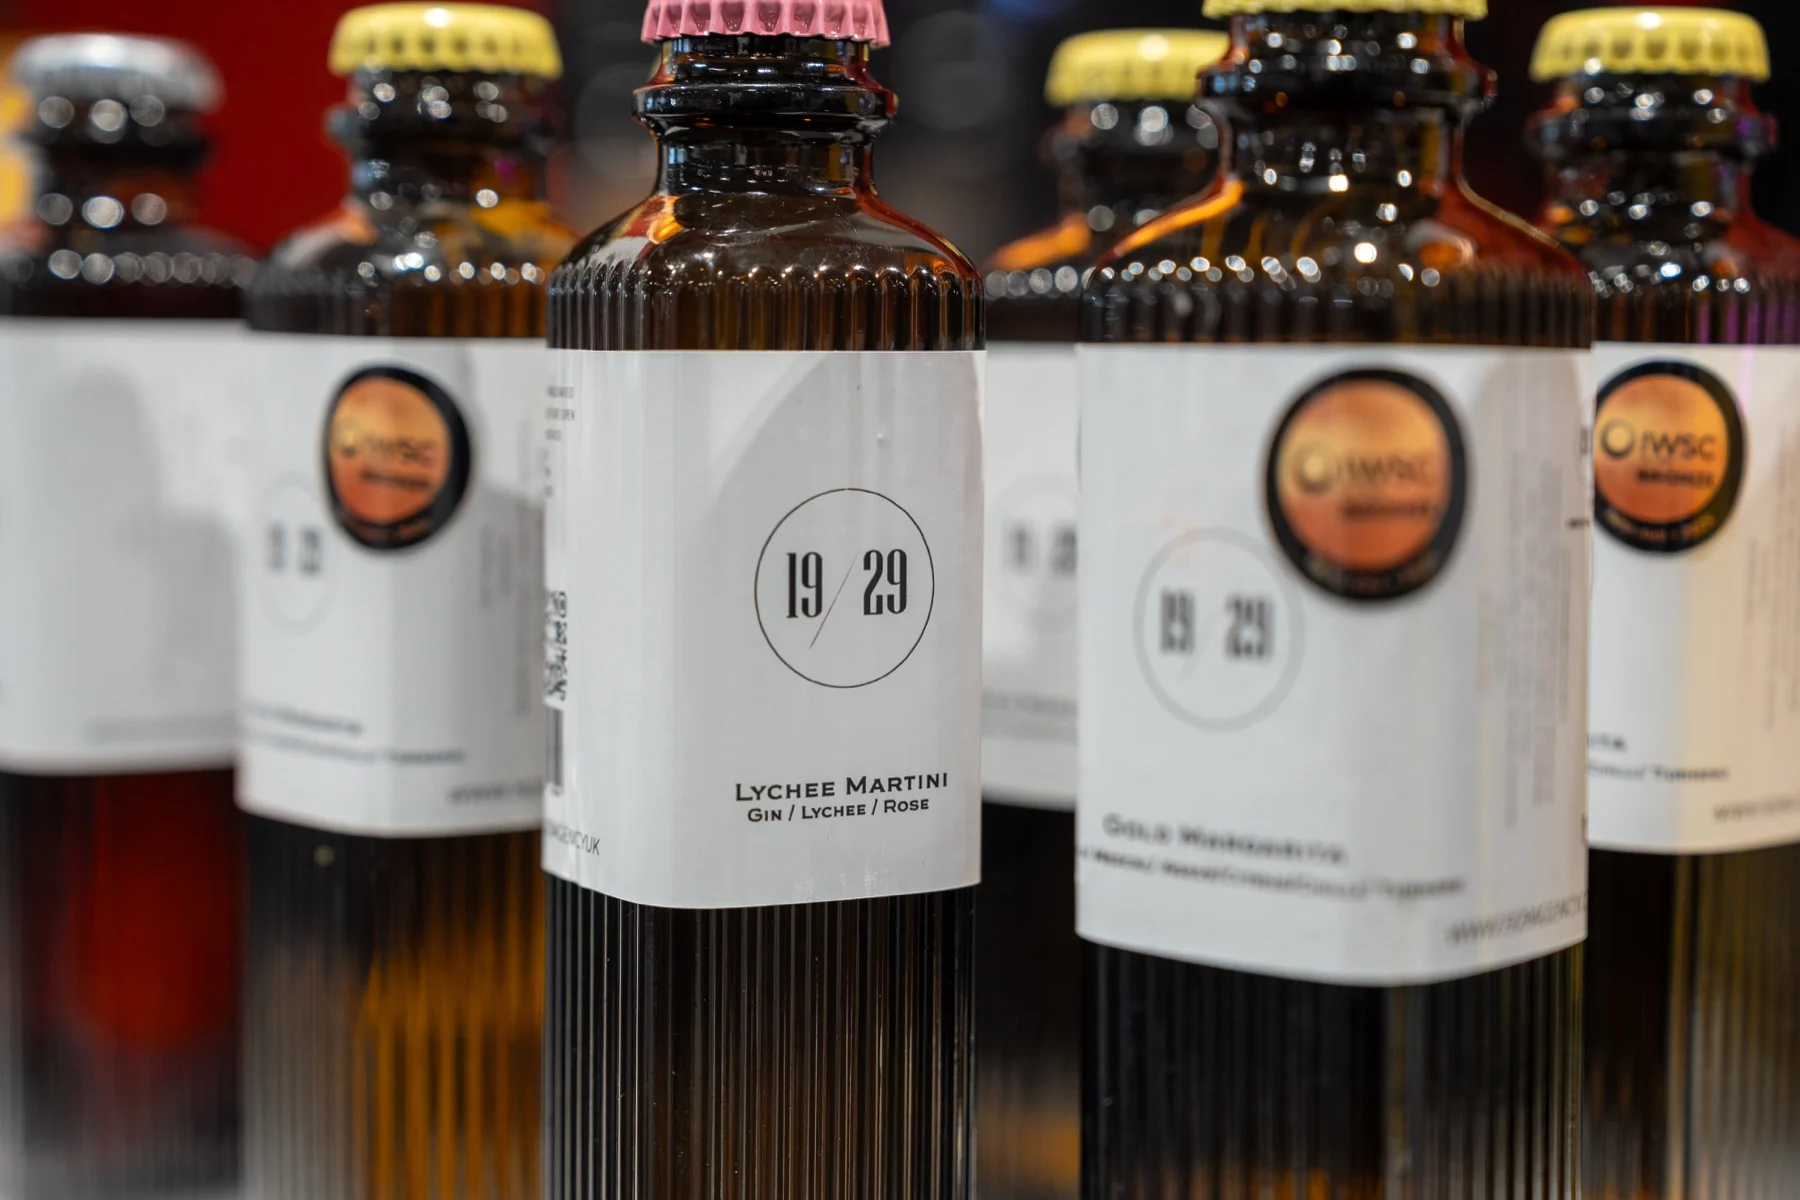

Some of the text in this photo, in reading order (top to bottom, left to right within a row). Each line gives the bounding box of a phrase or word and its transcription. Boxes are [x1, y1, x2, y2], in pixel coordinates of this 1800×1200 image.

[1640, 431, 1717, 461] IWSC
[735, 772, 949, 801] LYCHEE MARTINI
[747, 807, 782, 822] GIN
[801, 804, 867, 820] LYCHEE
[883, 798, 930, 814] ROSE
